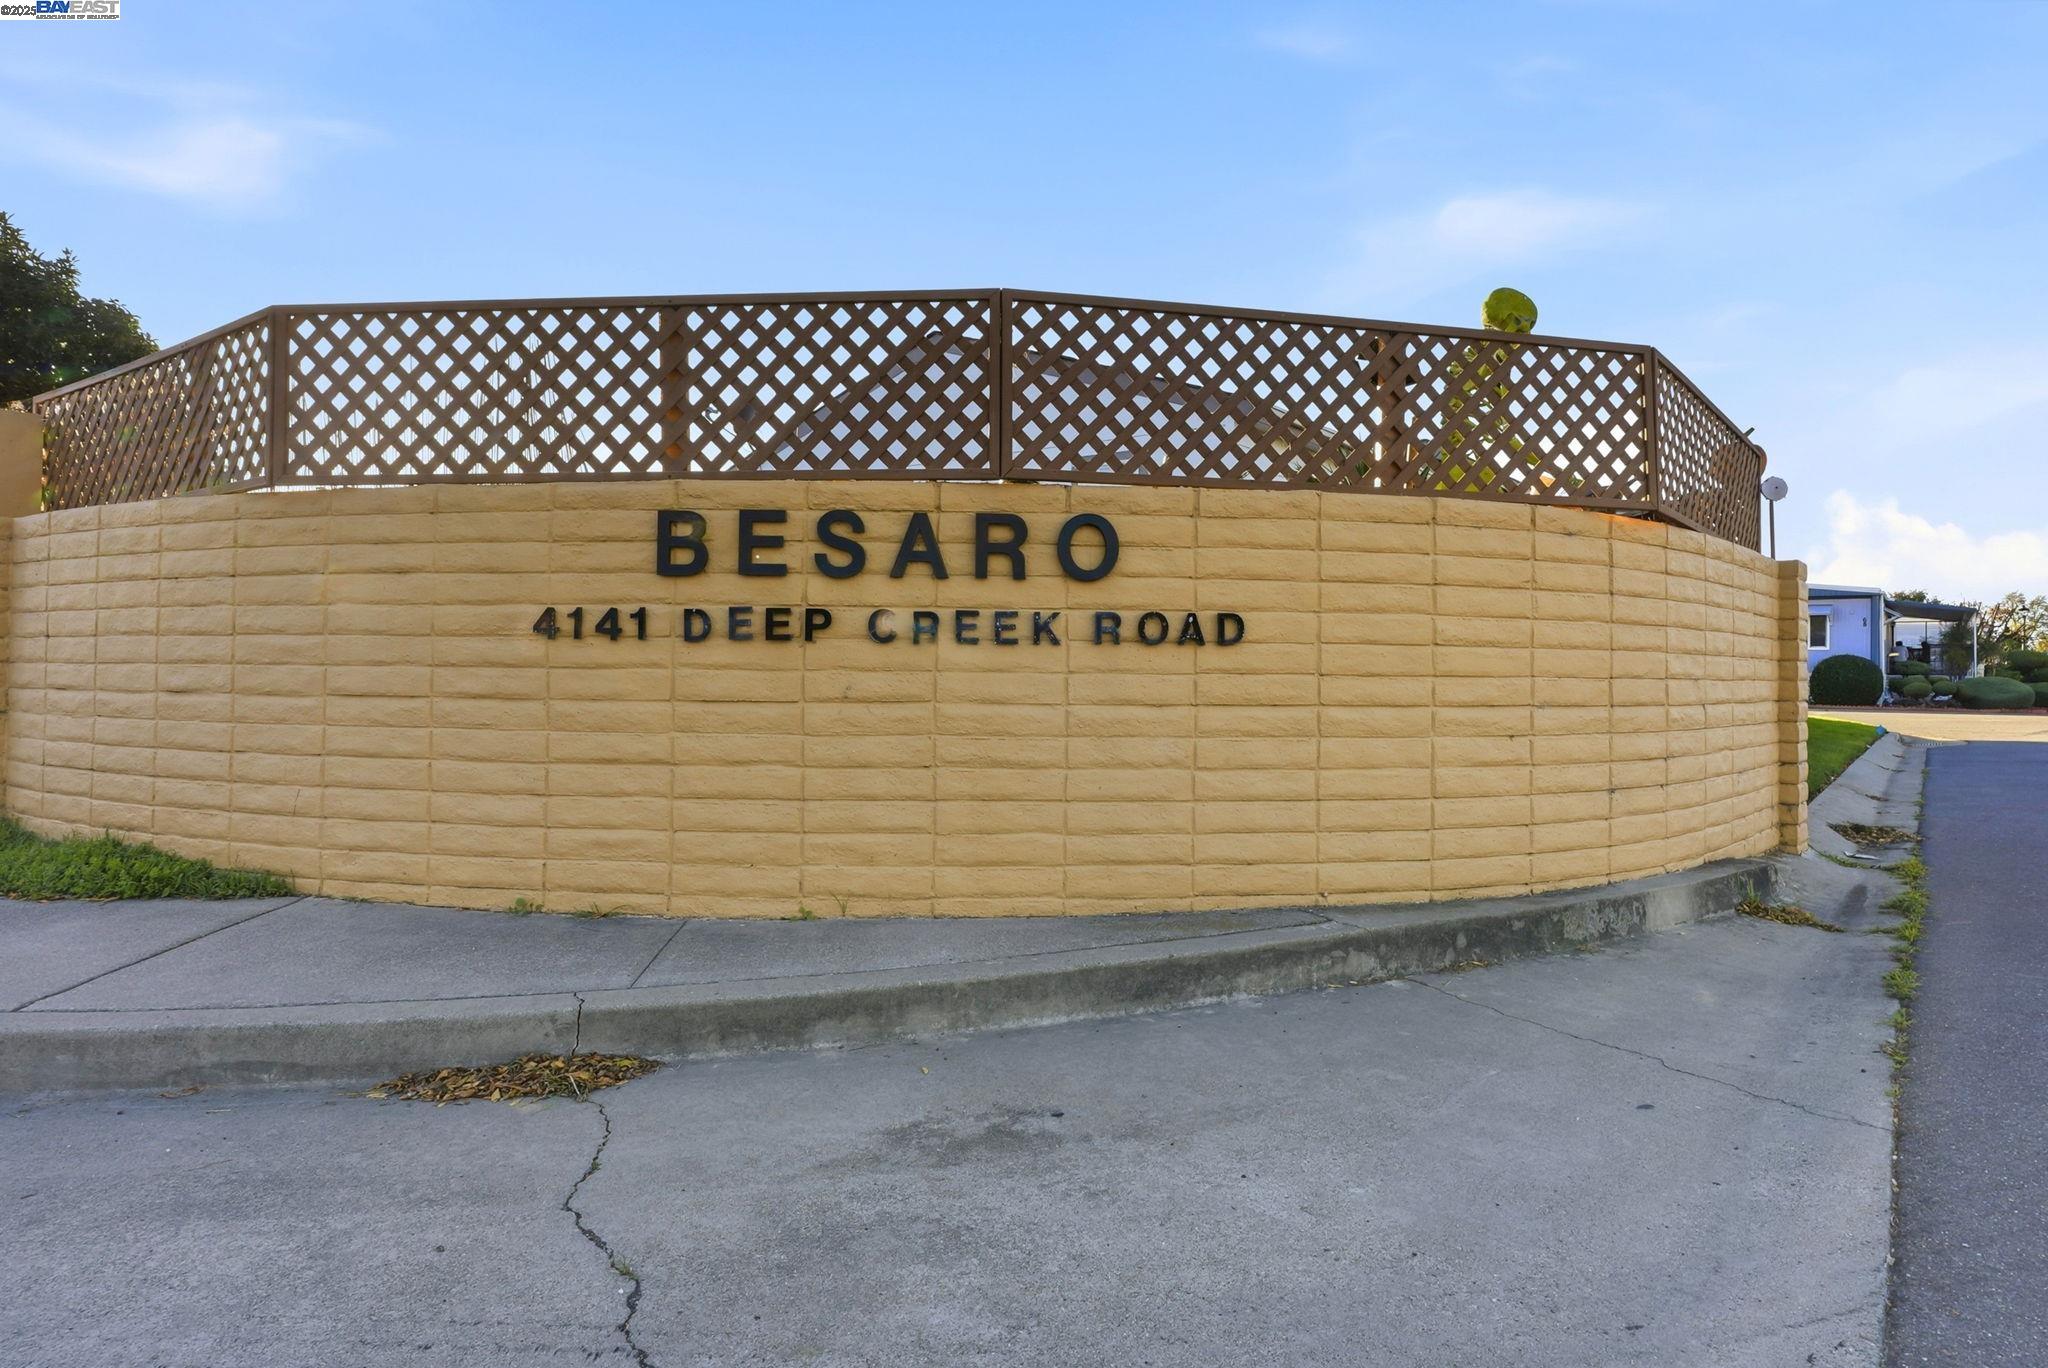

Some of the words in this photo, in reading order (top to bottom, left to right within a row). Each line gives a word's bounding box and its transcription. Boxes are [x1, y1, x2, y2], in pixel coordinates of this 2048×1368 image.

[655, 508, 1121, 584] BESARO
[533, 606, 648, 642] 4141
[682, 606, 832, 644] DEEP
[867, 608, 1062, 647] CREEK
[1092, 611, 1246, 649] ROAD
